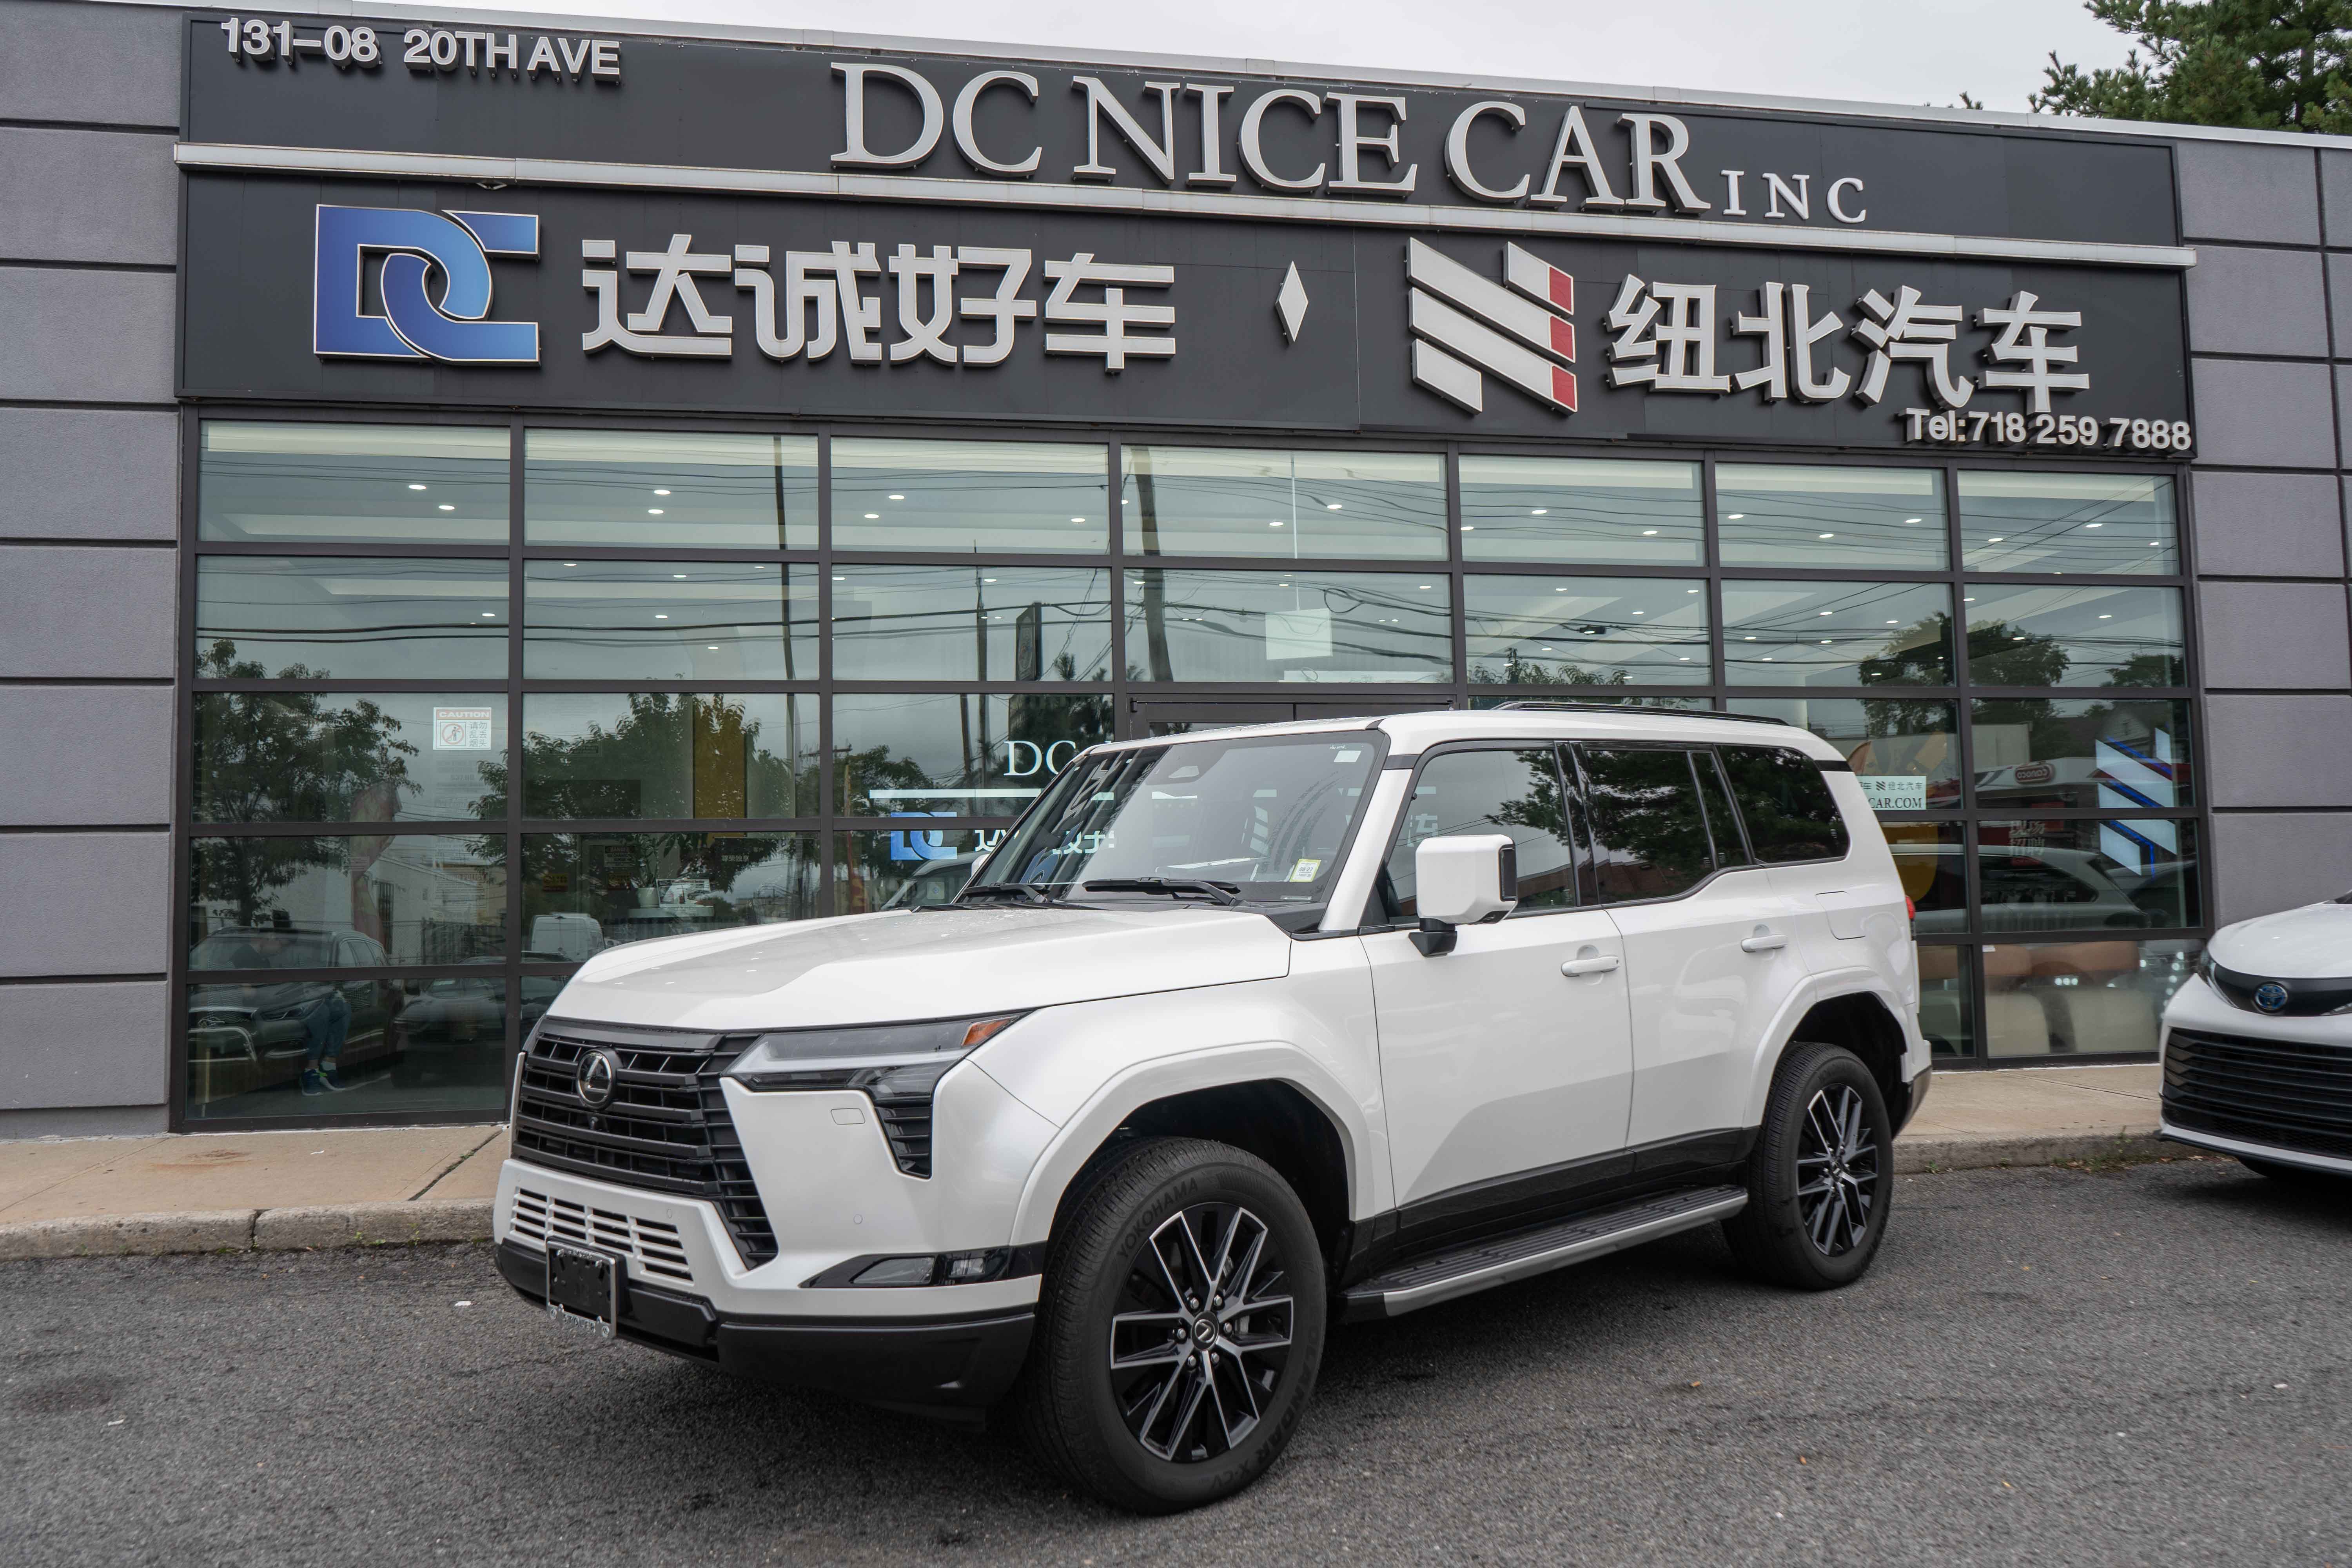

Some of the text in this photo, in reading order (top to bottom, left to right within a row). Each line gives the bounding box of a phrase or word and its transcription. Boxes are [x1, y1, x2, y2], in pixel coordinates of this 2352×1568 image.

[221, 17, 621, 81] 131-08 20TH AVE
[830, 62, 1867, 224] DC NICE CAR INC
[314, 204, 540, 366] DC
[582, 234, 1176, 373] 达诚好车
[1604, 273, 2091, 413] 纽北汽车
[2035, 413, 2099, 448] 259
[2109, 417, 2193, 452] 7888
[469, 730, 487, 739] 乱丢
[469, 739, 487, 748] 烟头
[470, 721, 488, 730] 请勿
[1858, 781, 1872, 790] 车
[1868, 797, 1923, 808] CAR.COM
[1887, 781, 1923, 791] 纽北汽车
[1116, 1177, 1199, 1258] YOKOHAMA
